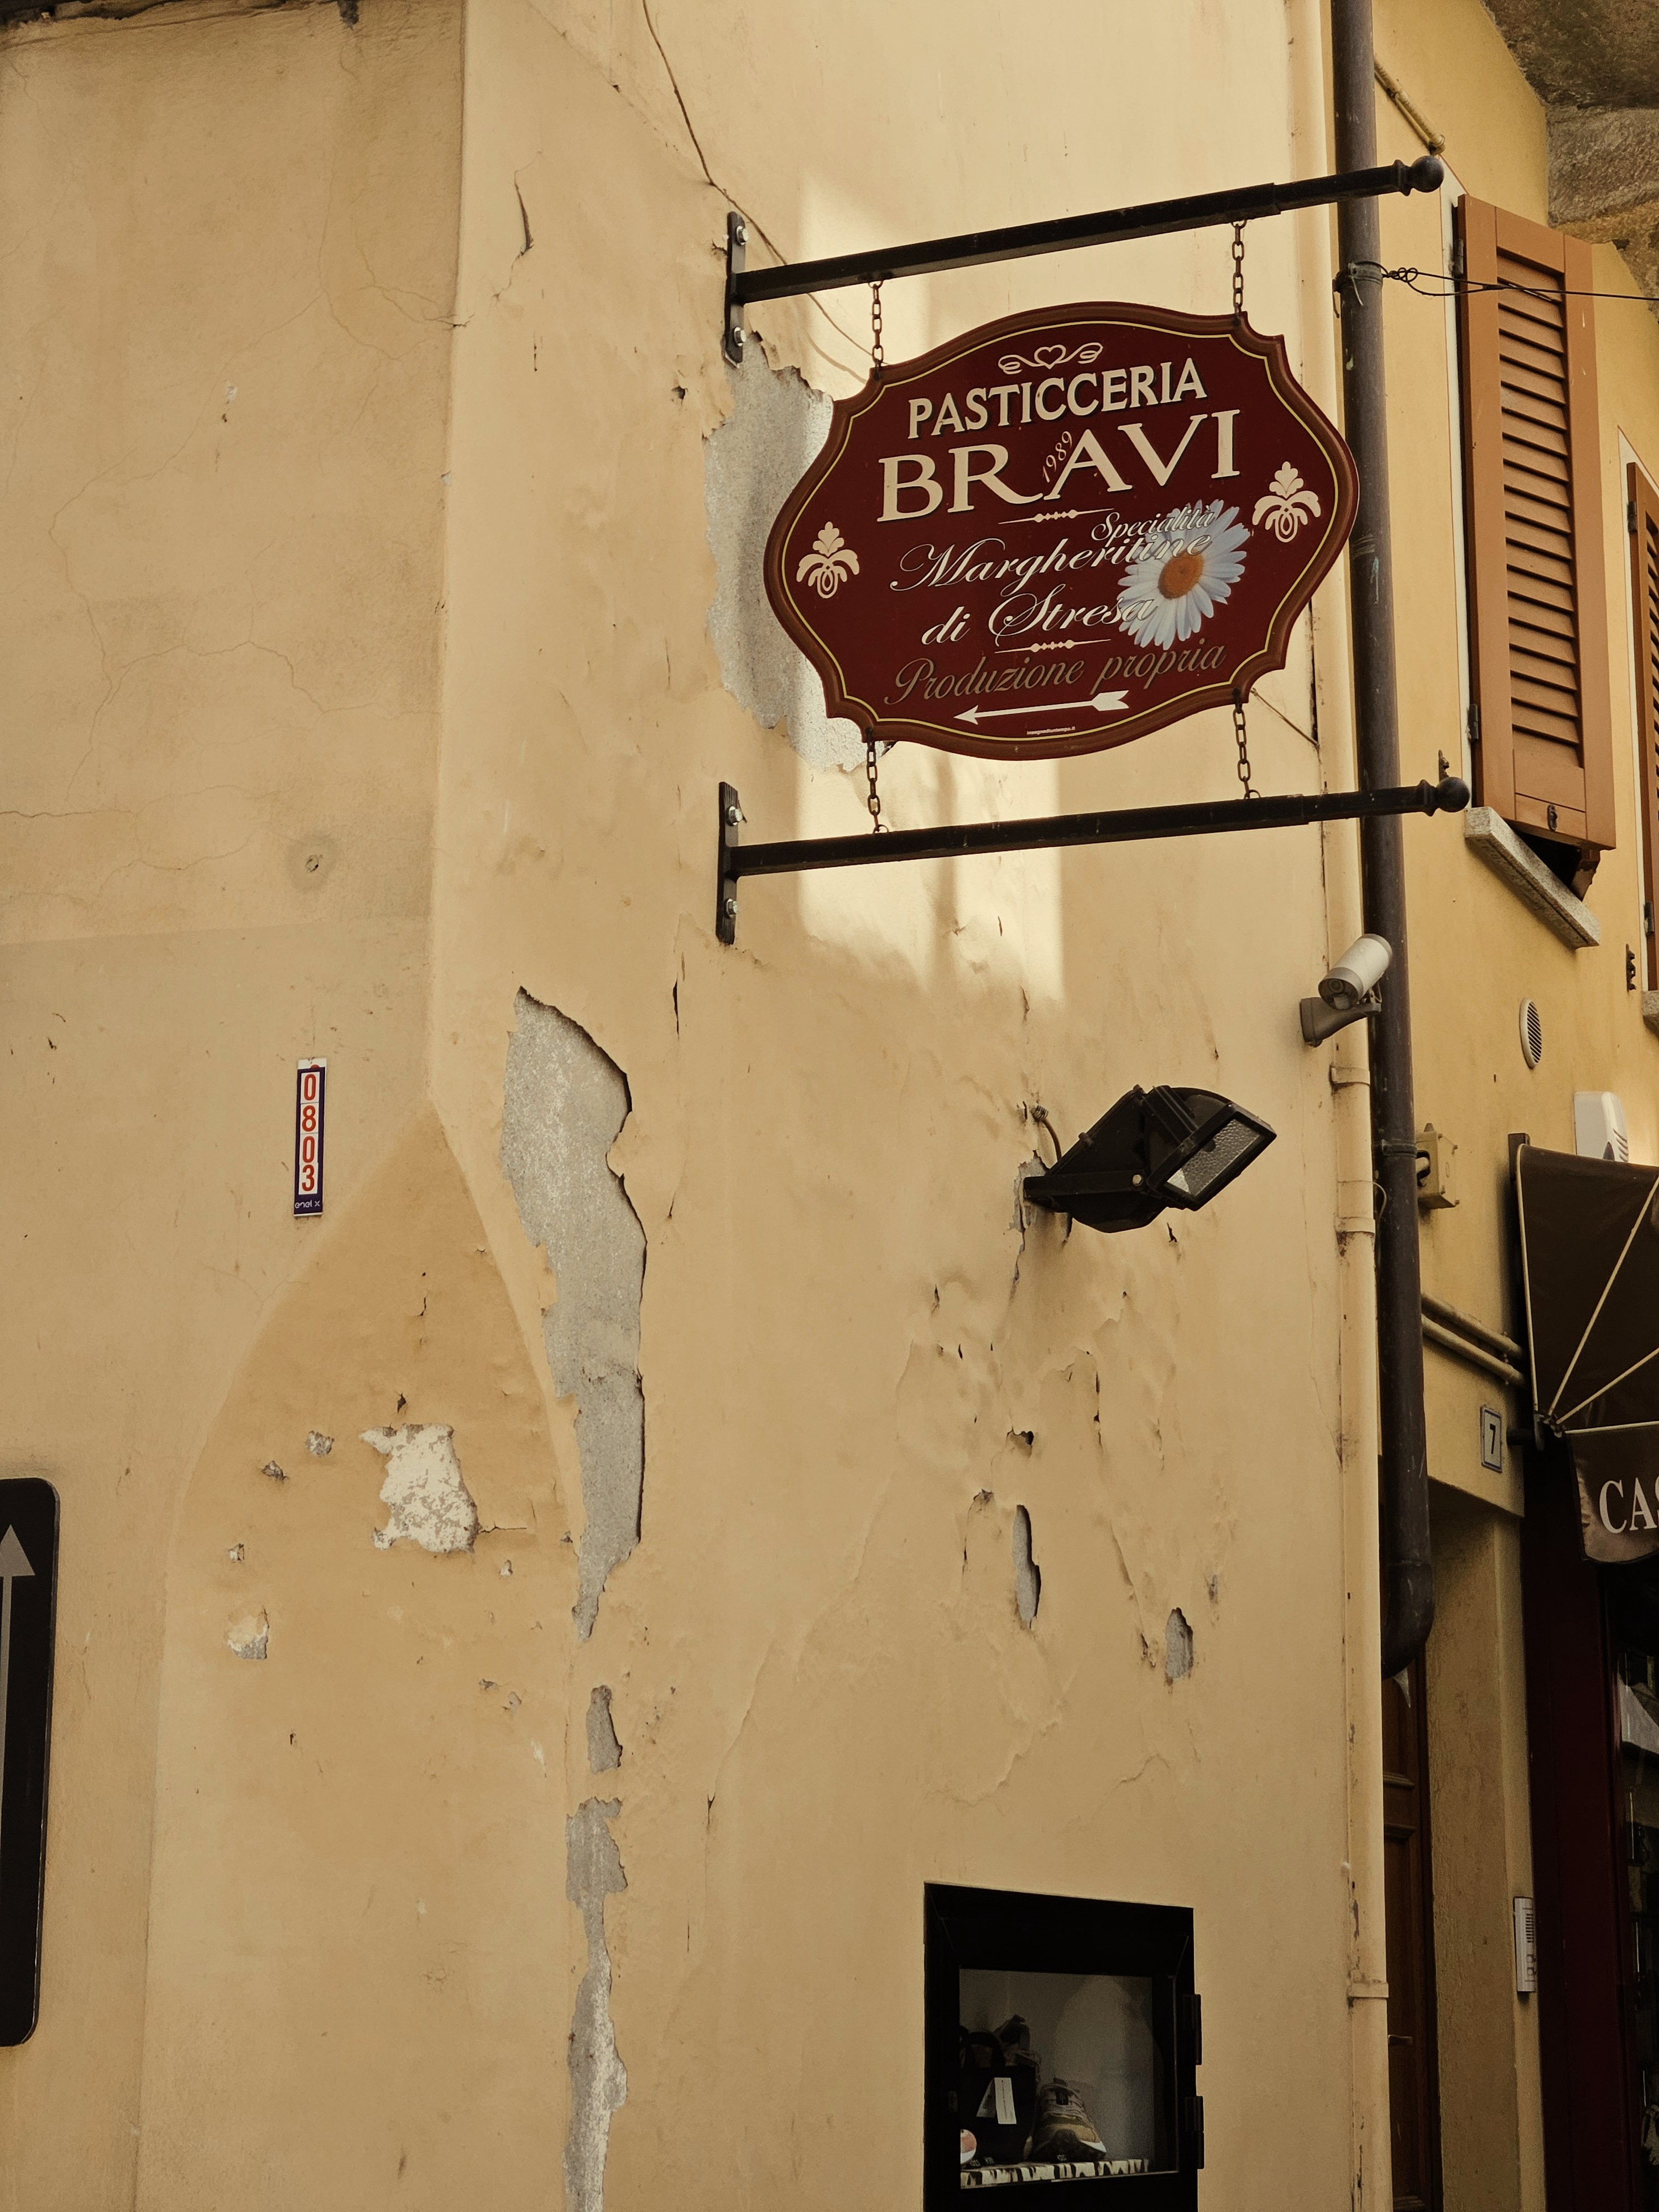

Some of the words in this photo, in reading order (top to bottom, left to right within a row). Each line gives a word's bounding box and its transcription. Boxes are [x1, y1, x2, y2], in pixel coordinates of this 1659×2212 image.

[907, 357, 1208, 439] PASTICCERIA
[877, 409, 1241, 522] BRAVI
[1042, 431, 1073, 483] 1989
[1091, 505, 1217, 548] Specialità
[890, 533, 1213, 597] Margheritine
[921, 606, 971, 645] di
[988, 583, 1159, 647] Stresa
[884, 656, 1085, 705] Produzione
[1089, 638, 1227, 695] propria
[301, 1073, 316, 1192] 0803
[295, 1199, 312, 1209] enel
[1489, 1423, 1496, 1454] 7
[1599, 1475, 1659, 1534] CA
